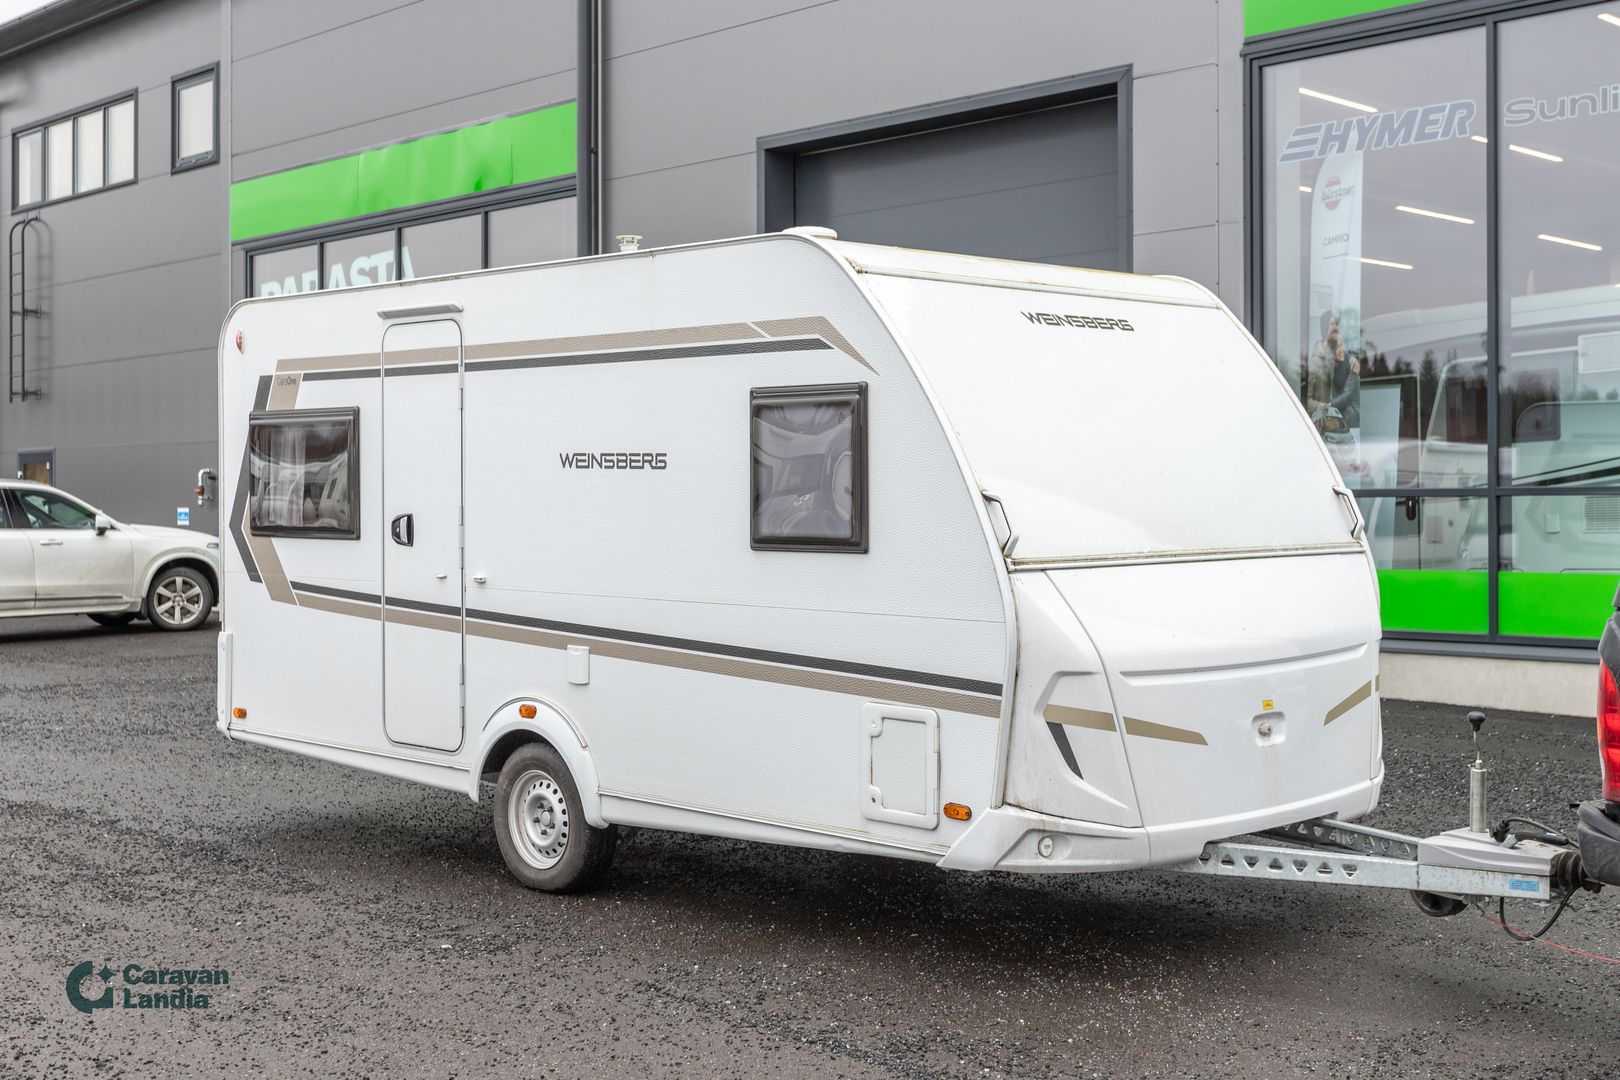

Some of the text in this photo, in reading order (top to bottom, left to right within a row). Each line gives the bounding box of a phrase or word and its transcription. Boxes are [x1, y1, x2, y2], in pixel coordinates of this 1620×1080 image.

[1316, 99, 1477, 159] HYMER
[1020, 311, 1135, 332] WEINSBERG
[559, 452, 668, 470] WEINSBERG
